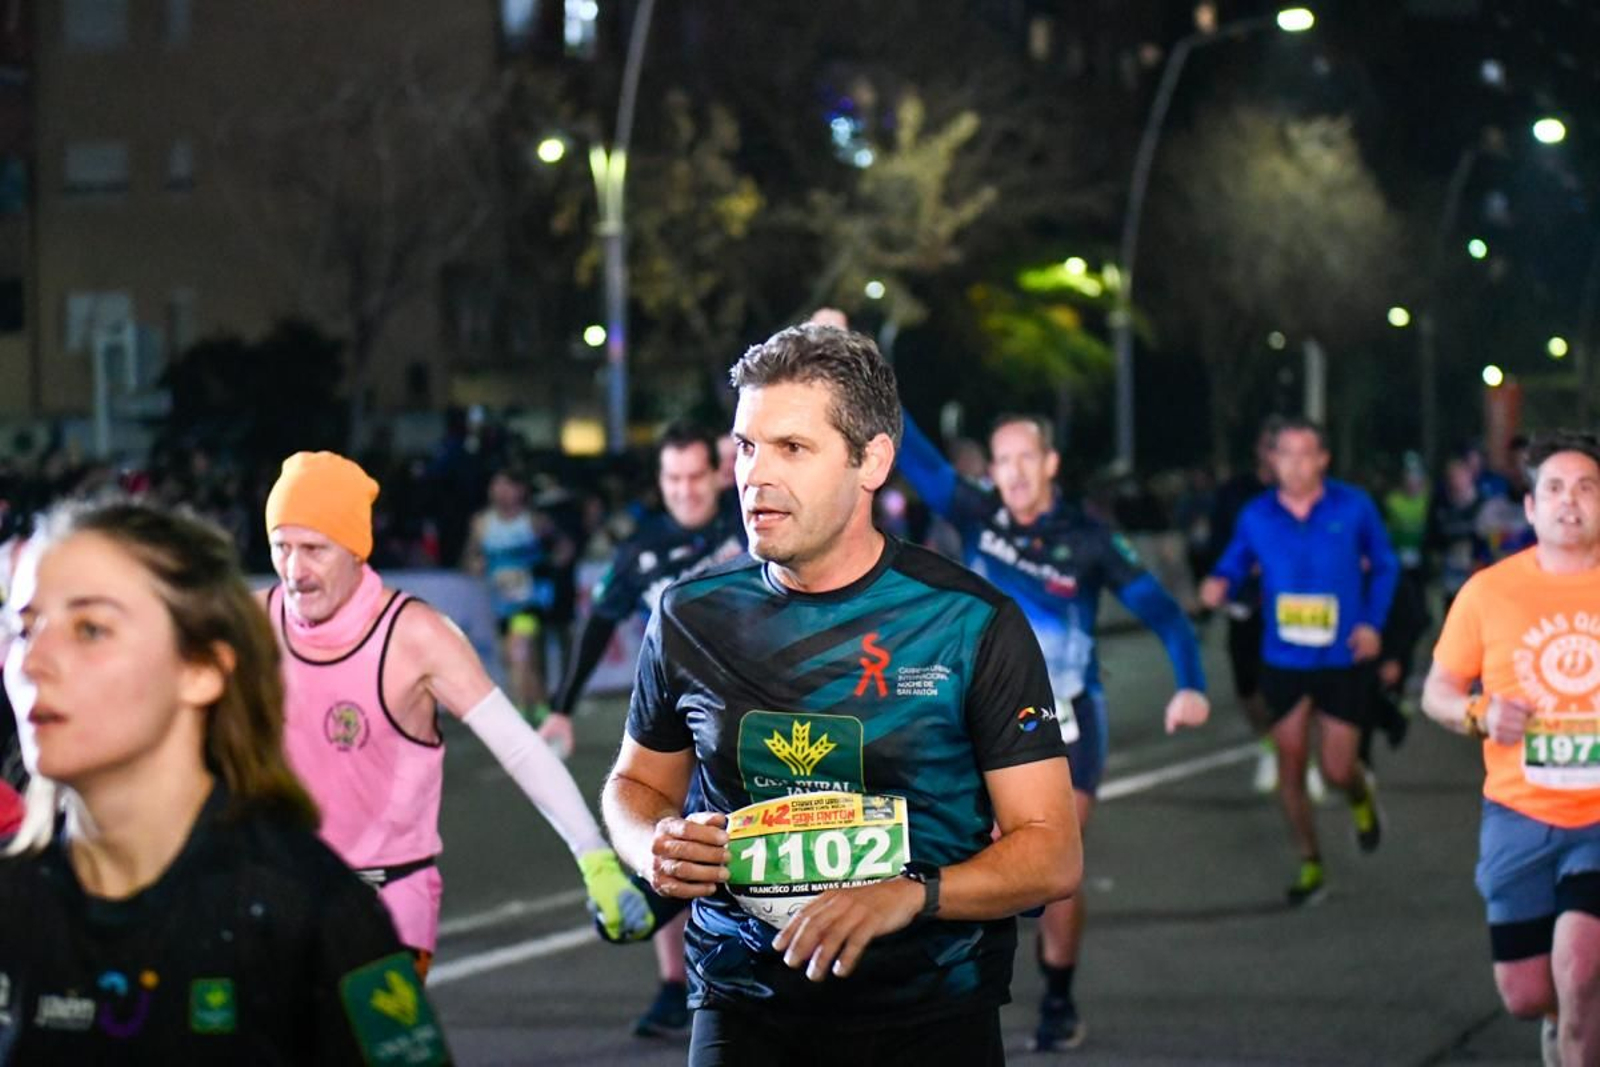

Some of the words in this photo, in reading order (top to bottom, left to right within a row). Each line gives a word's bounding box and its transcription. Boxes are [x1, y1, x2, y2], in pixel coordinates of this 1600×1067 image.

[897, 688, 911, 696] SAN
[1531, 735, 1600, 762] 197
[761, 804, 791, 827] 42
[791, 812, 814, 824] SAN
[741, 827, 892, 882] 1102
[749, 886, 790, 894] FRANCISCO
[811, 882, 839, 892] NAVAS
